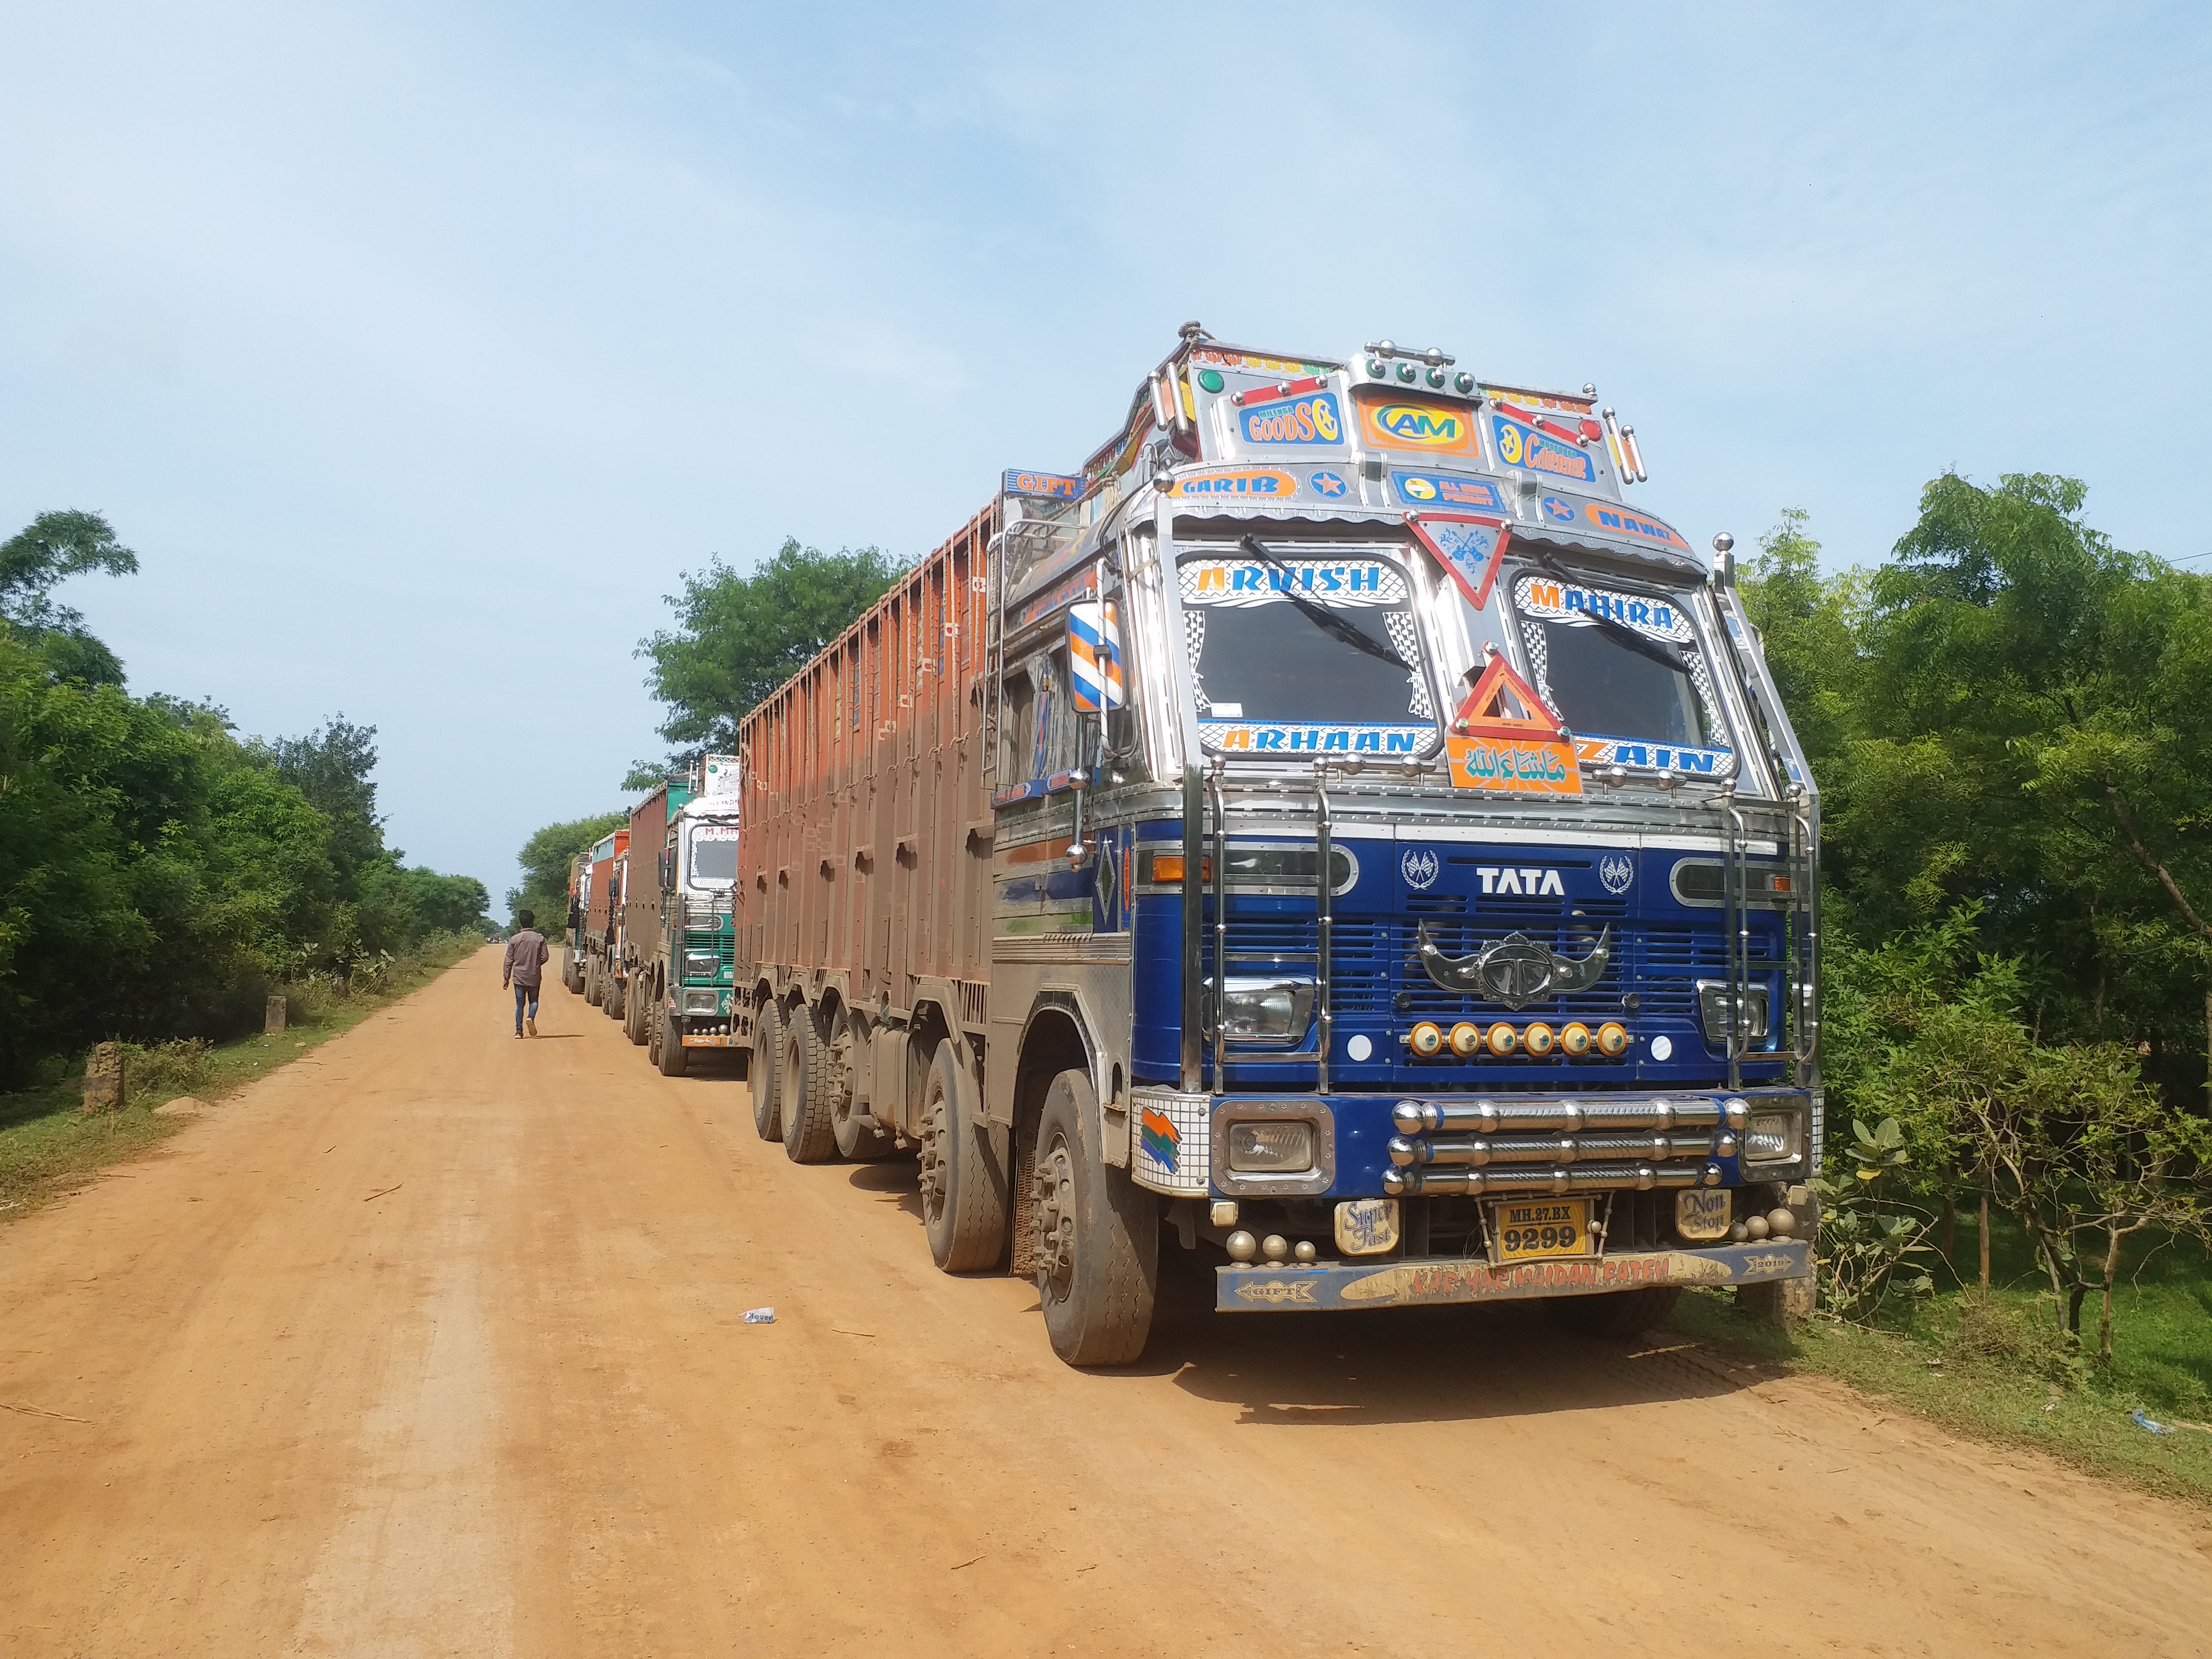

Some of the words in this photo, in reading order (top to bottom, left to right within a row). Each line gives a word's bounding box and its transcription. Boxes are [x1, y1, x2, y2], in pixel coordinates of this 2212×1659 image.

[1249, 403, 1315, 442] GOODS
[1259, 406, 1295, 420] MILENGA
[1390, 415, 1456, 439] AM
[1524, 433, 1587, 479] CARRIER
[1016, 474, 1076, 495] GIFT
[1183, 477, 1281, 493] GARIB
[1439, 481, 1459, 491] ALL
[1597, 509, 1672, 542] NAWAZ
[1197, 566, 1380, 591] ARVISH
[1530, 582, 1673, 629] MAHIRA
[1222, 729, 1416, 752] ARHAAN
[1576, 740, 1714, 773] ZAIN
[1476, 867, 1565, 896] TATA
[1344, 1202, 1394, 1234] Super
[1509, 1206, 1571, 1223] MH.27.BX
[1684, 1191, 1726, 1221] Non
[1690, 1215, 1725, 1234] Stop
[1350, 1226, 1391, 1252] Fast
[1504, 1226, 1576, 1252] 9299
[1757, 1260, 1784, 1268] 2019
